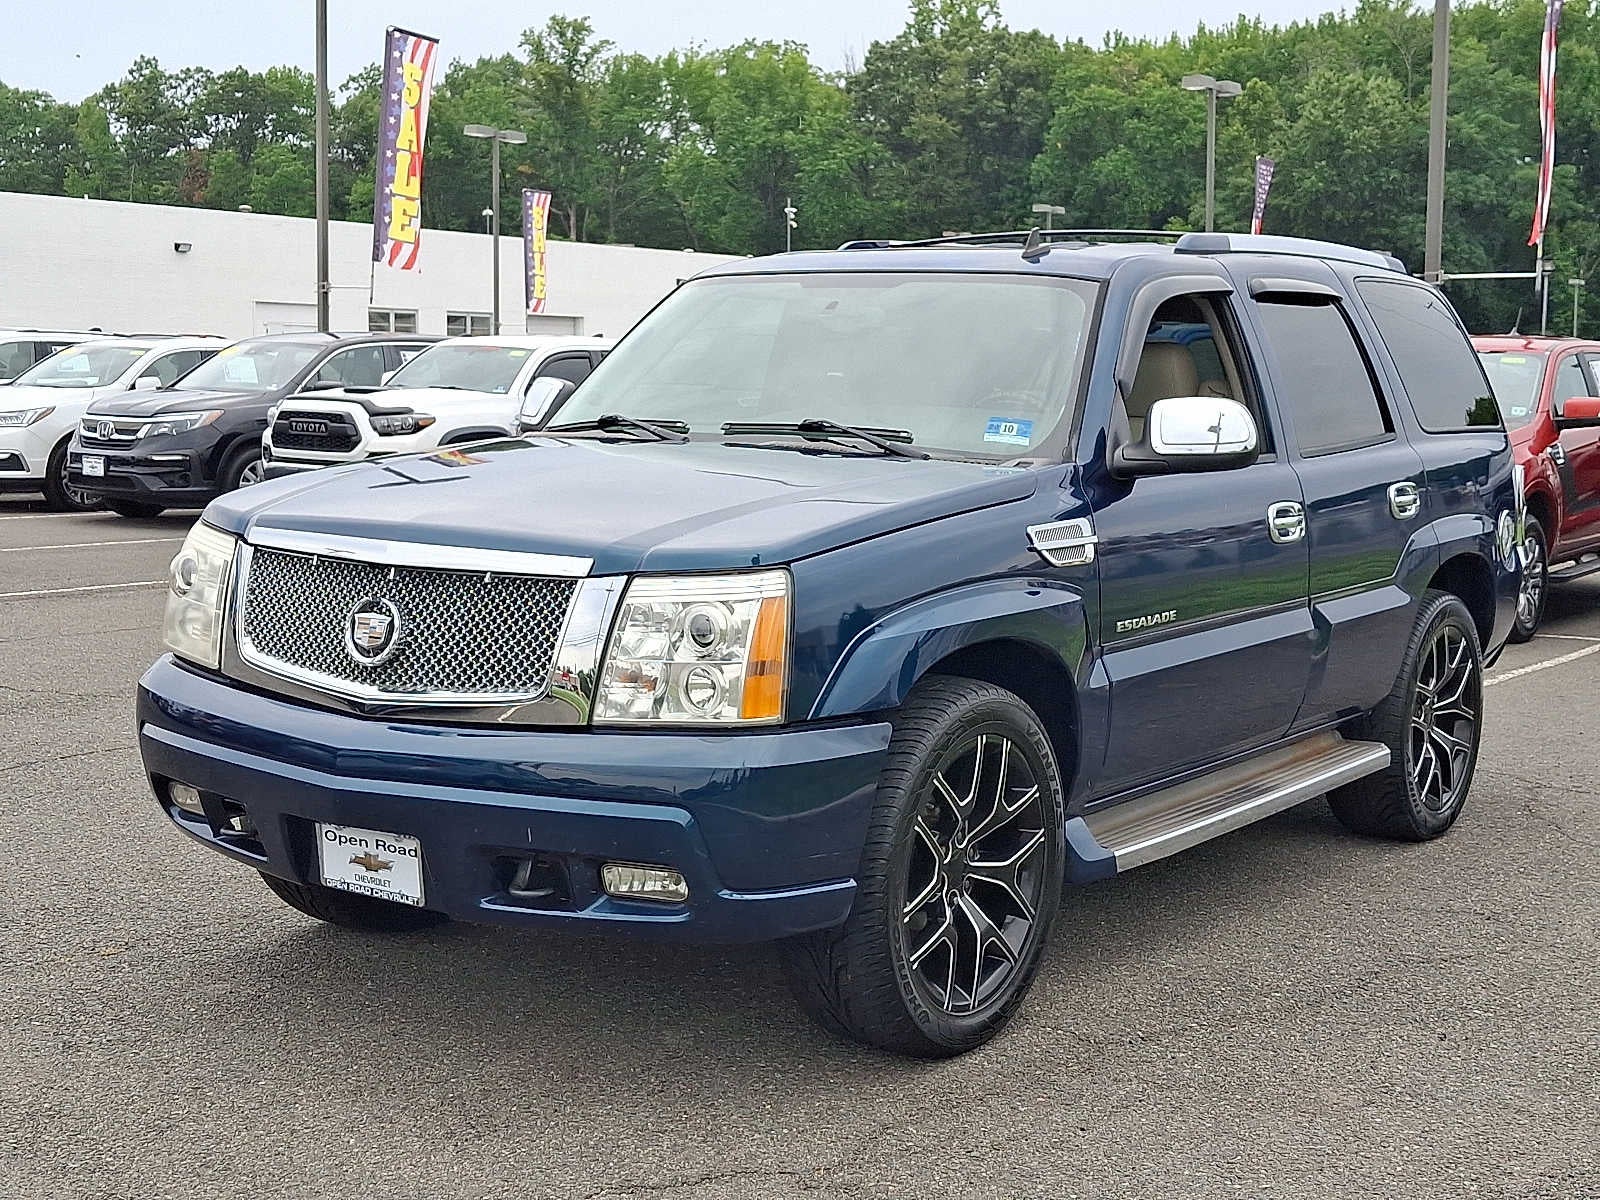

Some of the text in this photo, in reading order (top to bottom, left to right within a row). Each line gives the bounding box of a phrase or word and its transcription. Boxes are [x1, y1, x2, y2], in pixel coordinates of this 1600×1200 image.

[388, 62, 423, 243] SALE
[532, 205, 546, 299] SALE
[291, 422, 326, 433] TOYOTA
[1001, 423, 1015, 434] 10
[1116, 609, 1177, 633] ESCALADE
[324, 829, 418, 858] Open Road
[326, 878, 418, 906] OPEN ROAD CHEVROLET
[354, 873, 391, 888] CHEVROLET
